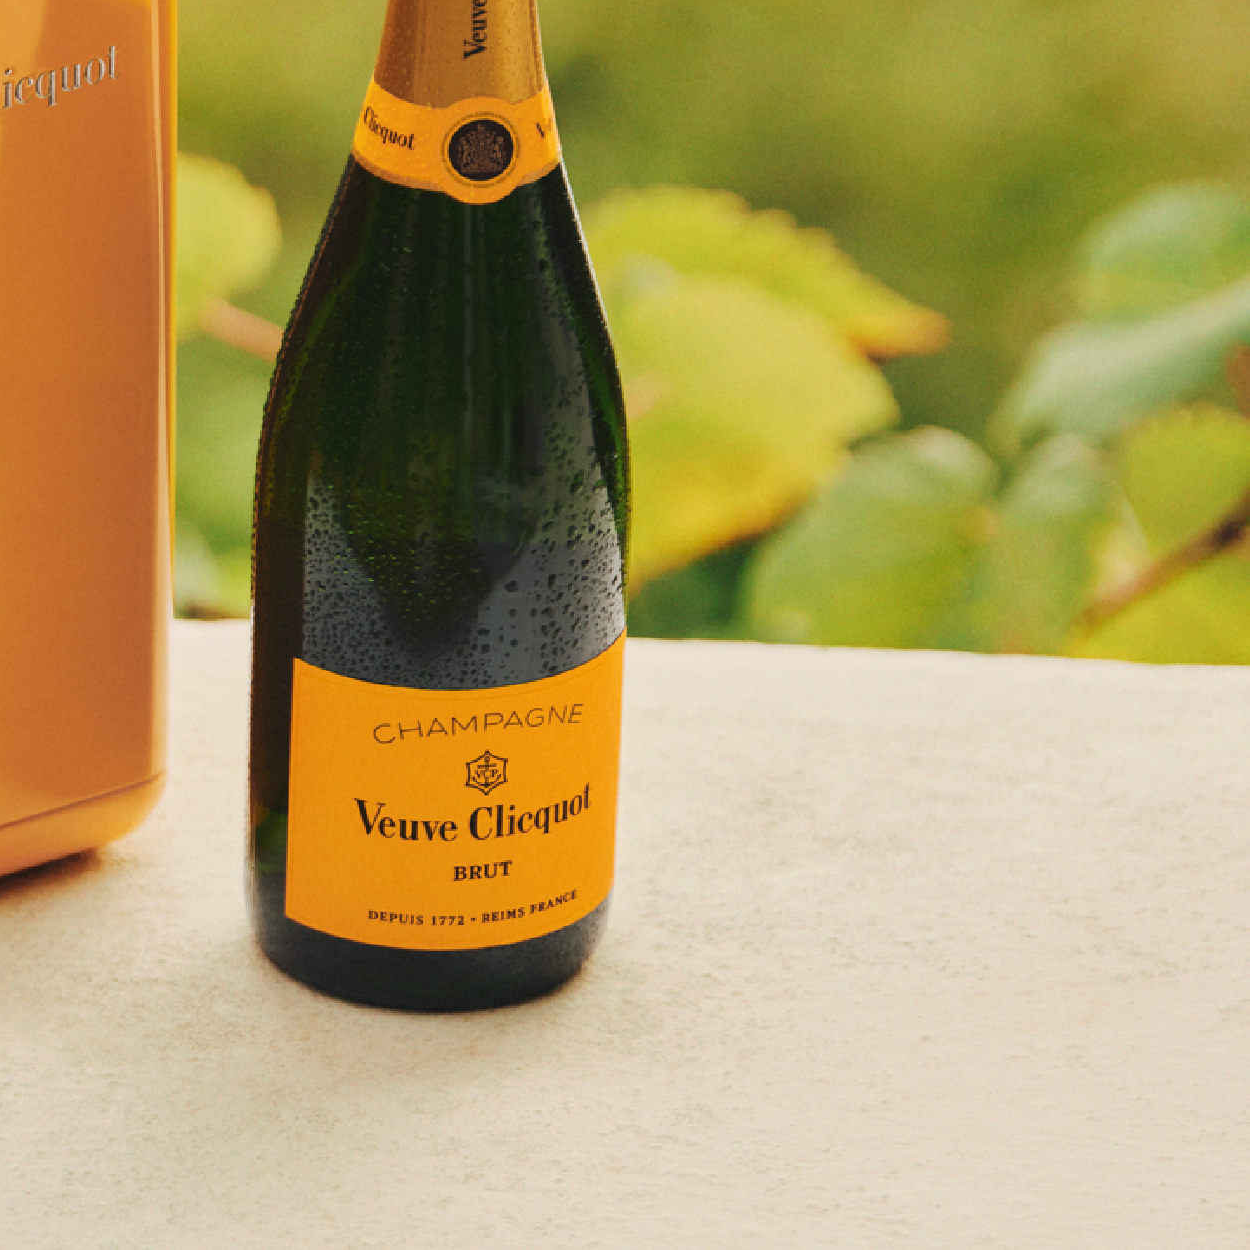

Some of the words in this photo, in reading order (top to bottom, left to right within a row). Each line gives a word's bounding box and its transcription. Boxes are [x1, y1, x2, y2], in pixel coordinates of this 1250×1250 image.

[373, 703, 584, 744] CHAMPAGNE
[353, 797, 458, 841] Veuve
[468, 782, 591, 840] Clicquot
[452, 860, 512, 881] BRUT
[368, 909, 424, 925] DEPUIS
[431, 914, 464, 925] 1772
[481, 907, 525, 924] REIMS
[530, 889, 578, 915] FRANCE
